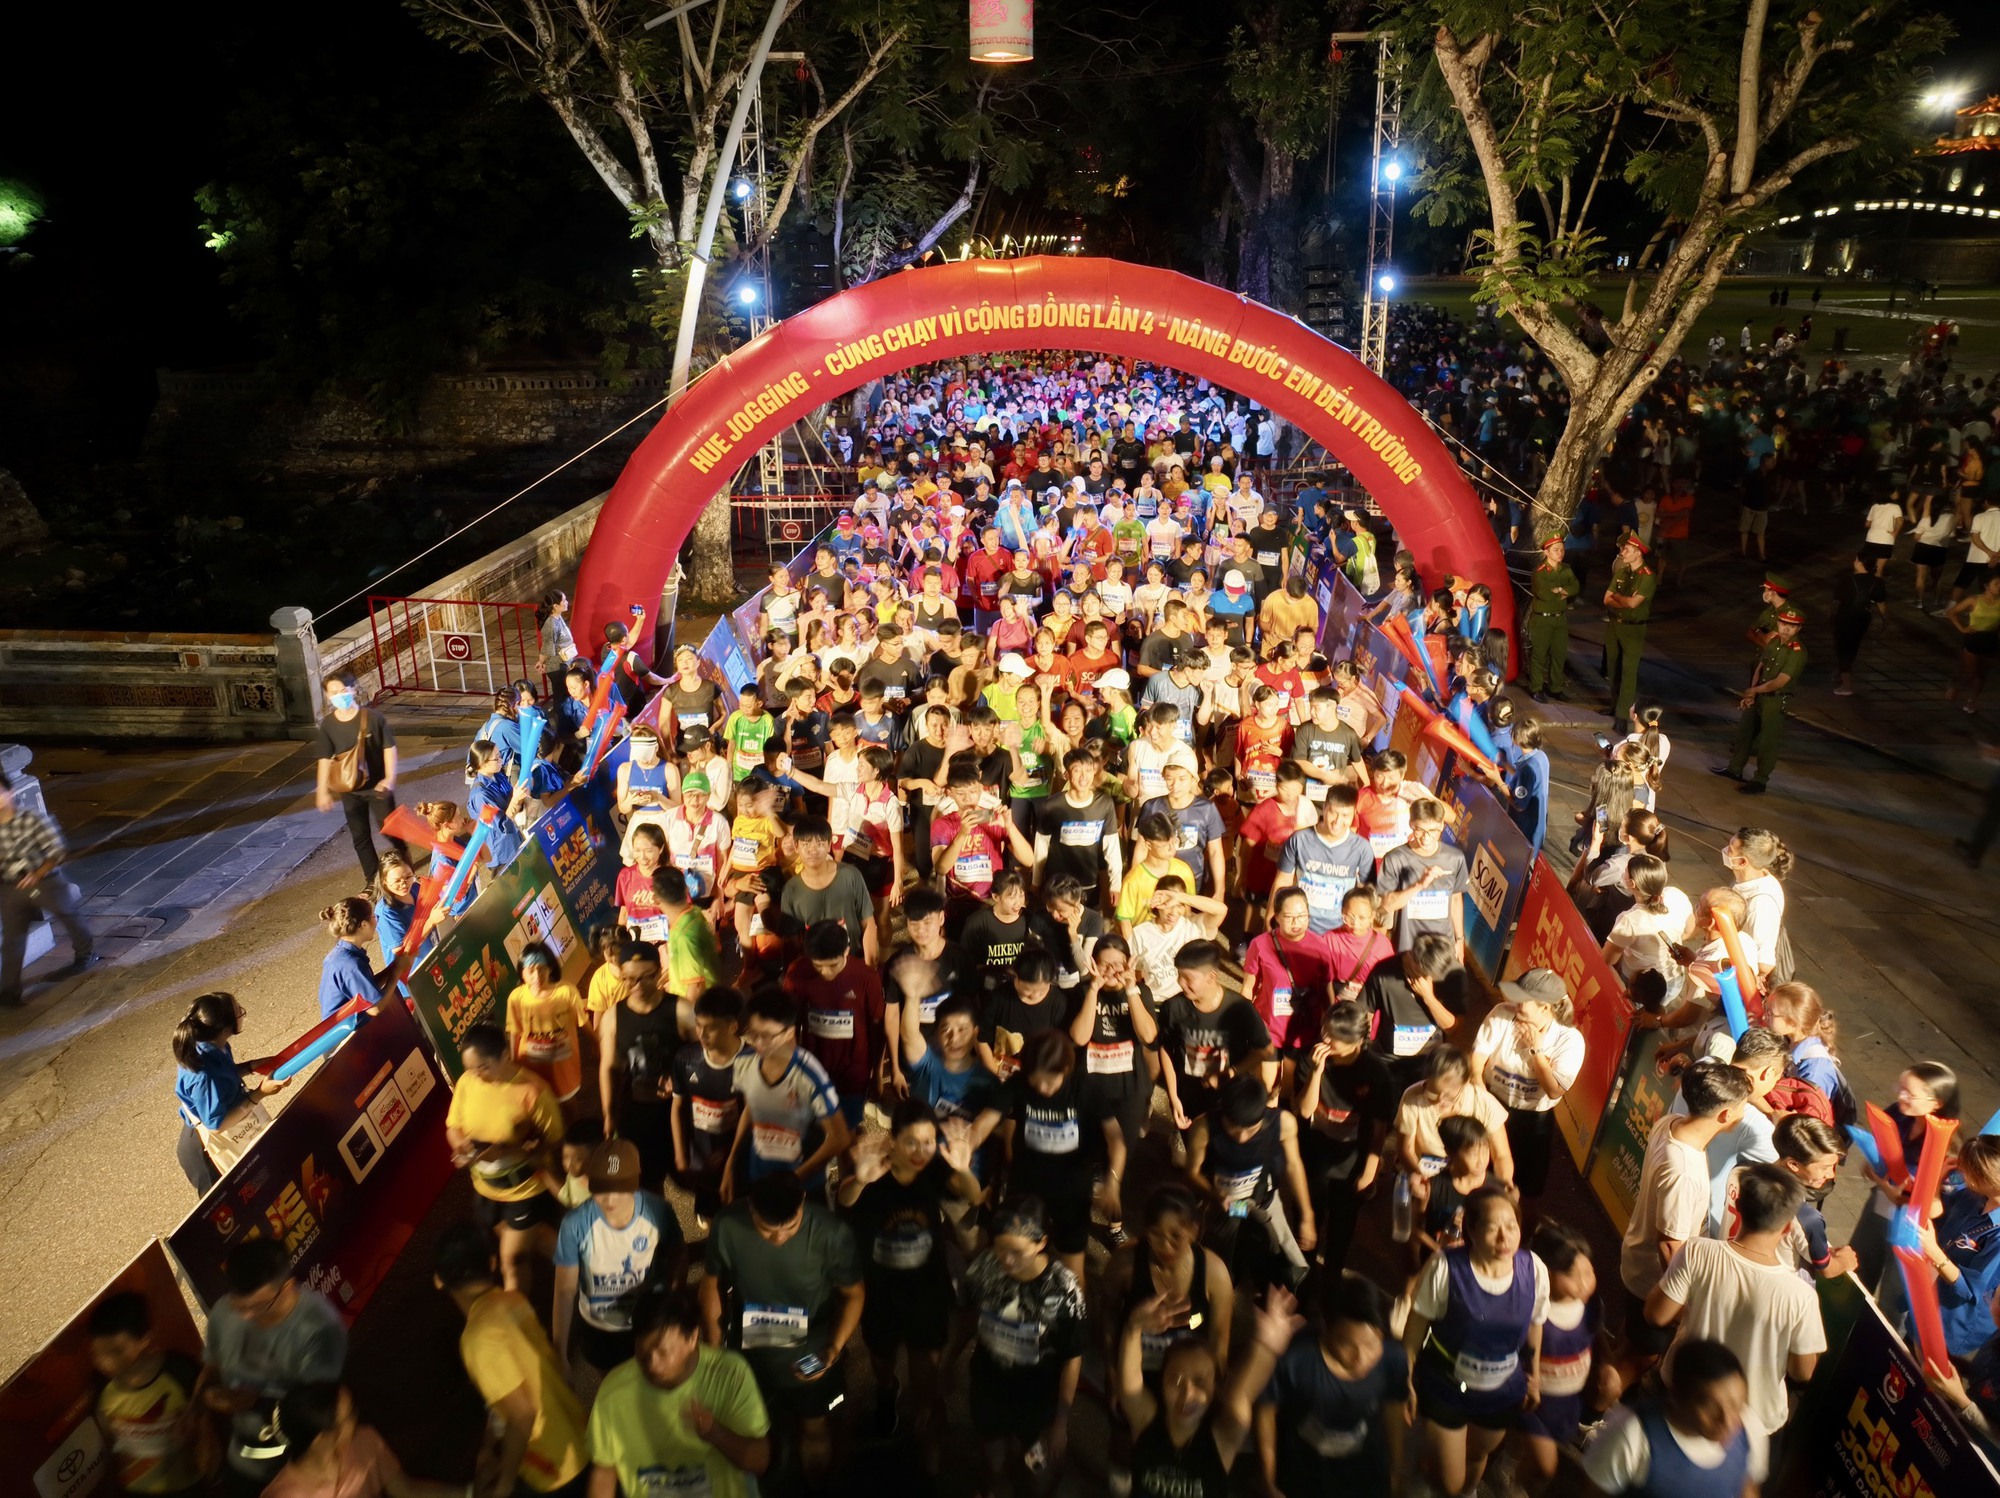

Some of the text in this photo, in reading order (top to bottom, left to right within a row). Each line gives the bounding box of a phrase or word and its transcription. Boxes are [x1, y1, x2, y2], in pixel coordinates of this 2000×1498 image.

[689, 432, 733, 474] HUE
[824, 342, 886, 376] CÙNG
[882, 316, 937, 352] CHẠY
[938, 305, 963, 337] VÌ
[964, 300, 1024, 334] CỘNG
[1027, 292, 1091, 327] ĐỒNG
[1093, 295, 1139, 333] LẦN
[1139, 311, 1153, 335] 4
[1167, 318, 1231, 358] NÂNG
[1227, 345, 1288, 380] BƯỚC
[1282, 364, 1321, 400] EM
[1312, 386, 1359, 427] ĐẾN
[1350, 408, 1422, 485] TRƯỜNG
[451, 644, 466, 652] STOP
[1323, 742, 1345, 753] YONEX
[550, 825, 590, 877] HUE
[561, 847, 596, 887] JOGGING
[1322, 864, 1350, 877] YONEX
[437, 960, 488, 1032] HUE
[452, 985, 493, 1043] JOGGING
[1624, 1118, 1640, 1139] RACE
[1833, 1440, 1859, 1478] RACE
[1846, 1384, 1936, 1498] HU
